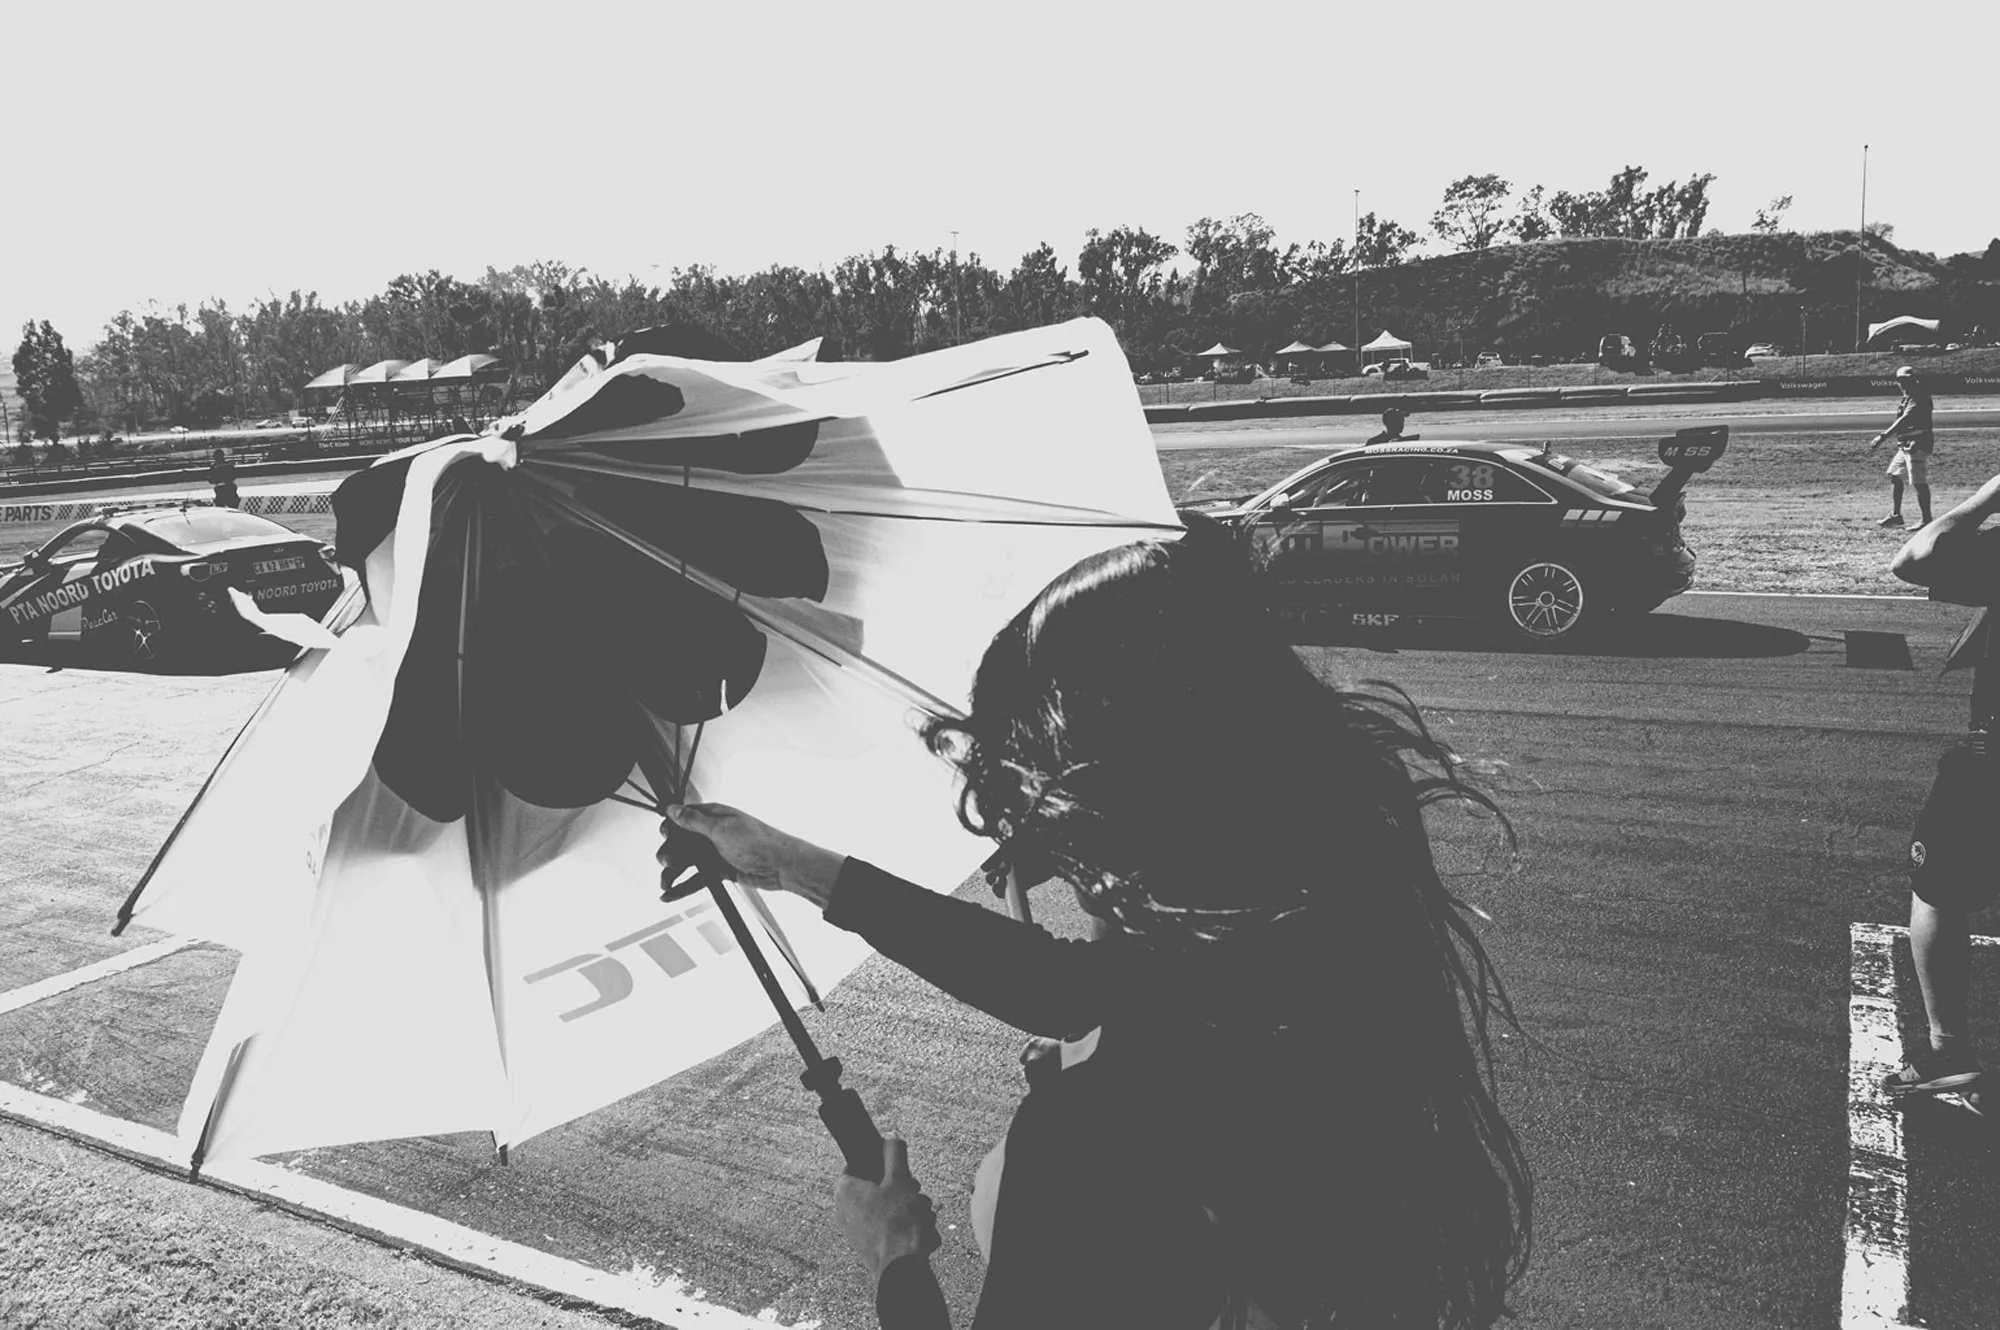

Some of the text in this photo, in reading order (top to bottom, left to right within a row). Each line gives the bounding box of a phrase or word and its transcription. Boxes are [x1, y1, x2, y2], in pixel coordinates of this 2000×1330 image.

[1780, 381, 1827, 390] Volkswagen
[1870, 379, 1898, 387] Volksw
[1449, 465, 1494, 489] 38
[1447, 489, 1493, 501] MOSS
[4, 505, 52, 522] PARTS
[9, 558, 156, 625] PTA NOORD TOYOTA
[257, 585, 297, 600] NOORD
[301, 579, 338, 594] TOYOTA
[1351, 613, 1399, 627] SKF
